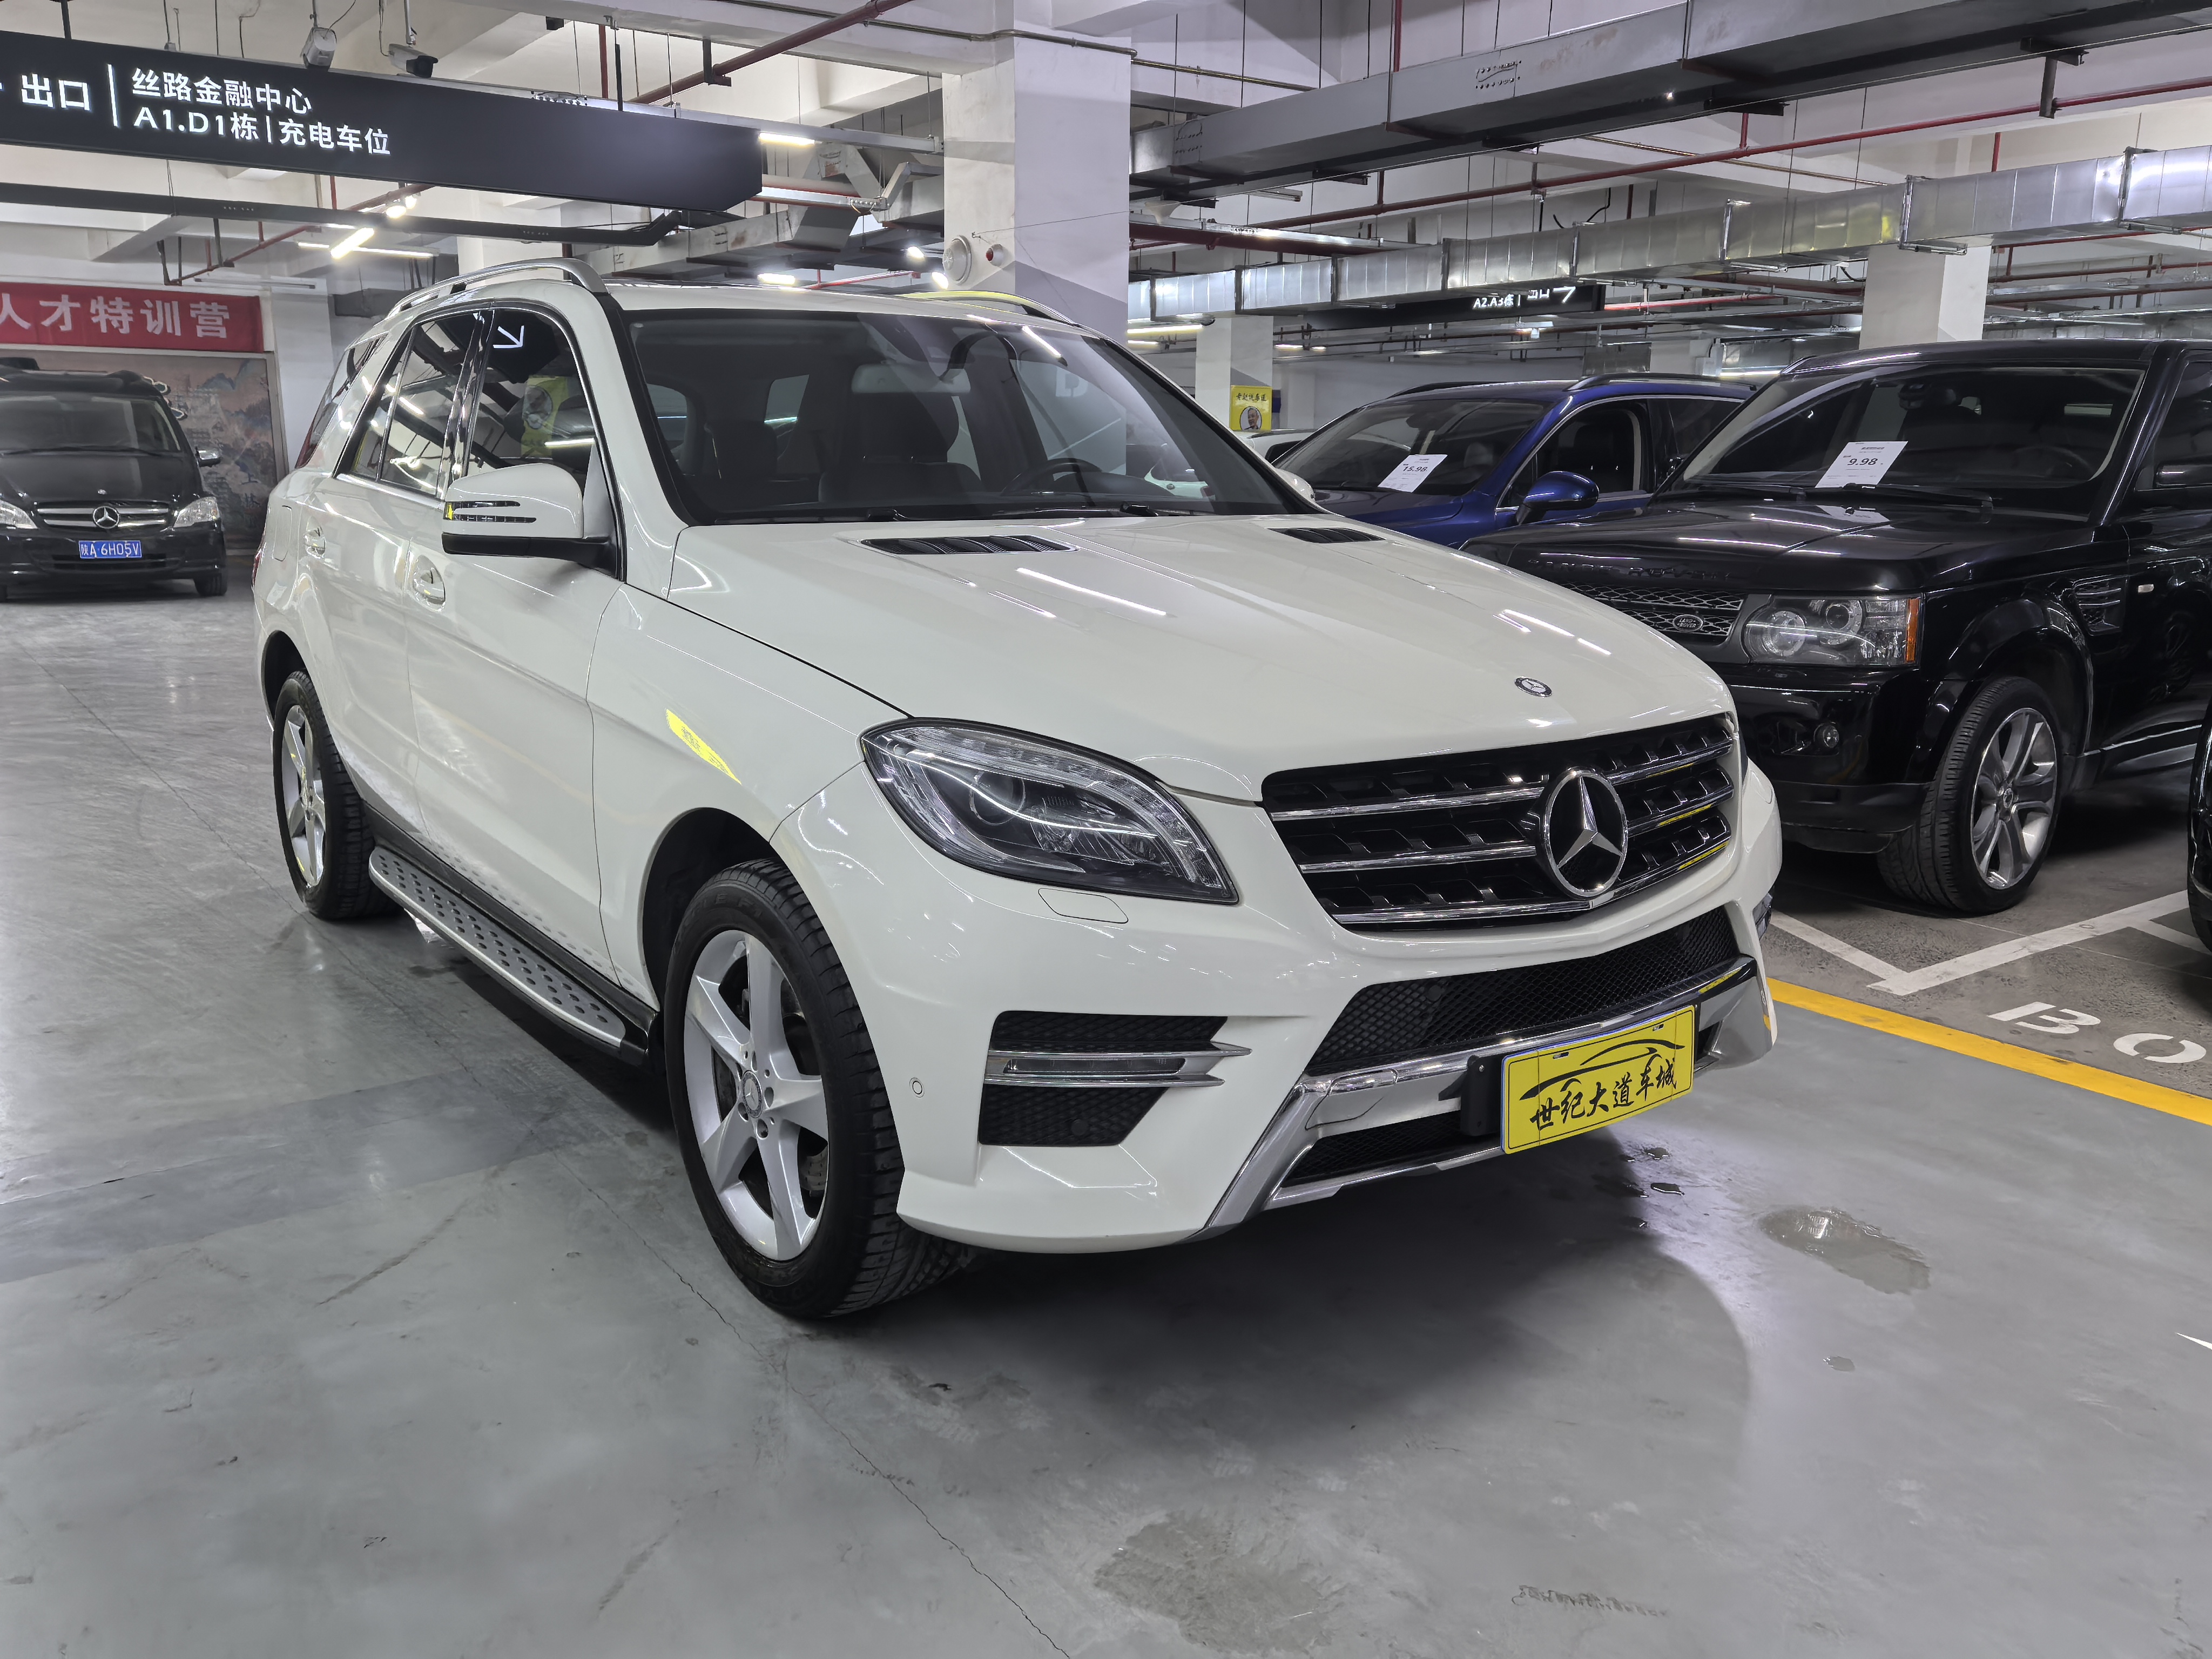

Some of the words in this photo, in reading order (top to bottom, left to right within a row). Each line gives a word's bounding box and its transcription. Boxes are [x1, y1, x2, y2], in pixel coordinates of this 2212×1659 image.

[21, 73, 90, 111] 出口
[132, 68, 312, 114] 丝路金融中心
[0, 293, 230, 339] 人才特训营
[1529, 1057, 1677, 1131] 世纪大道车城
